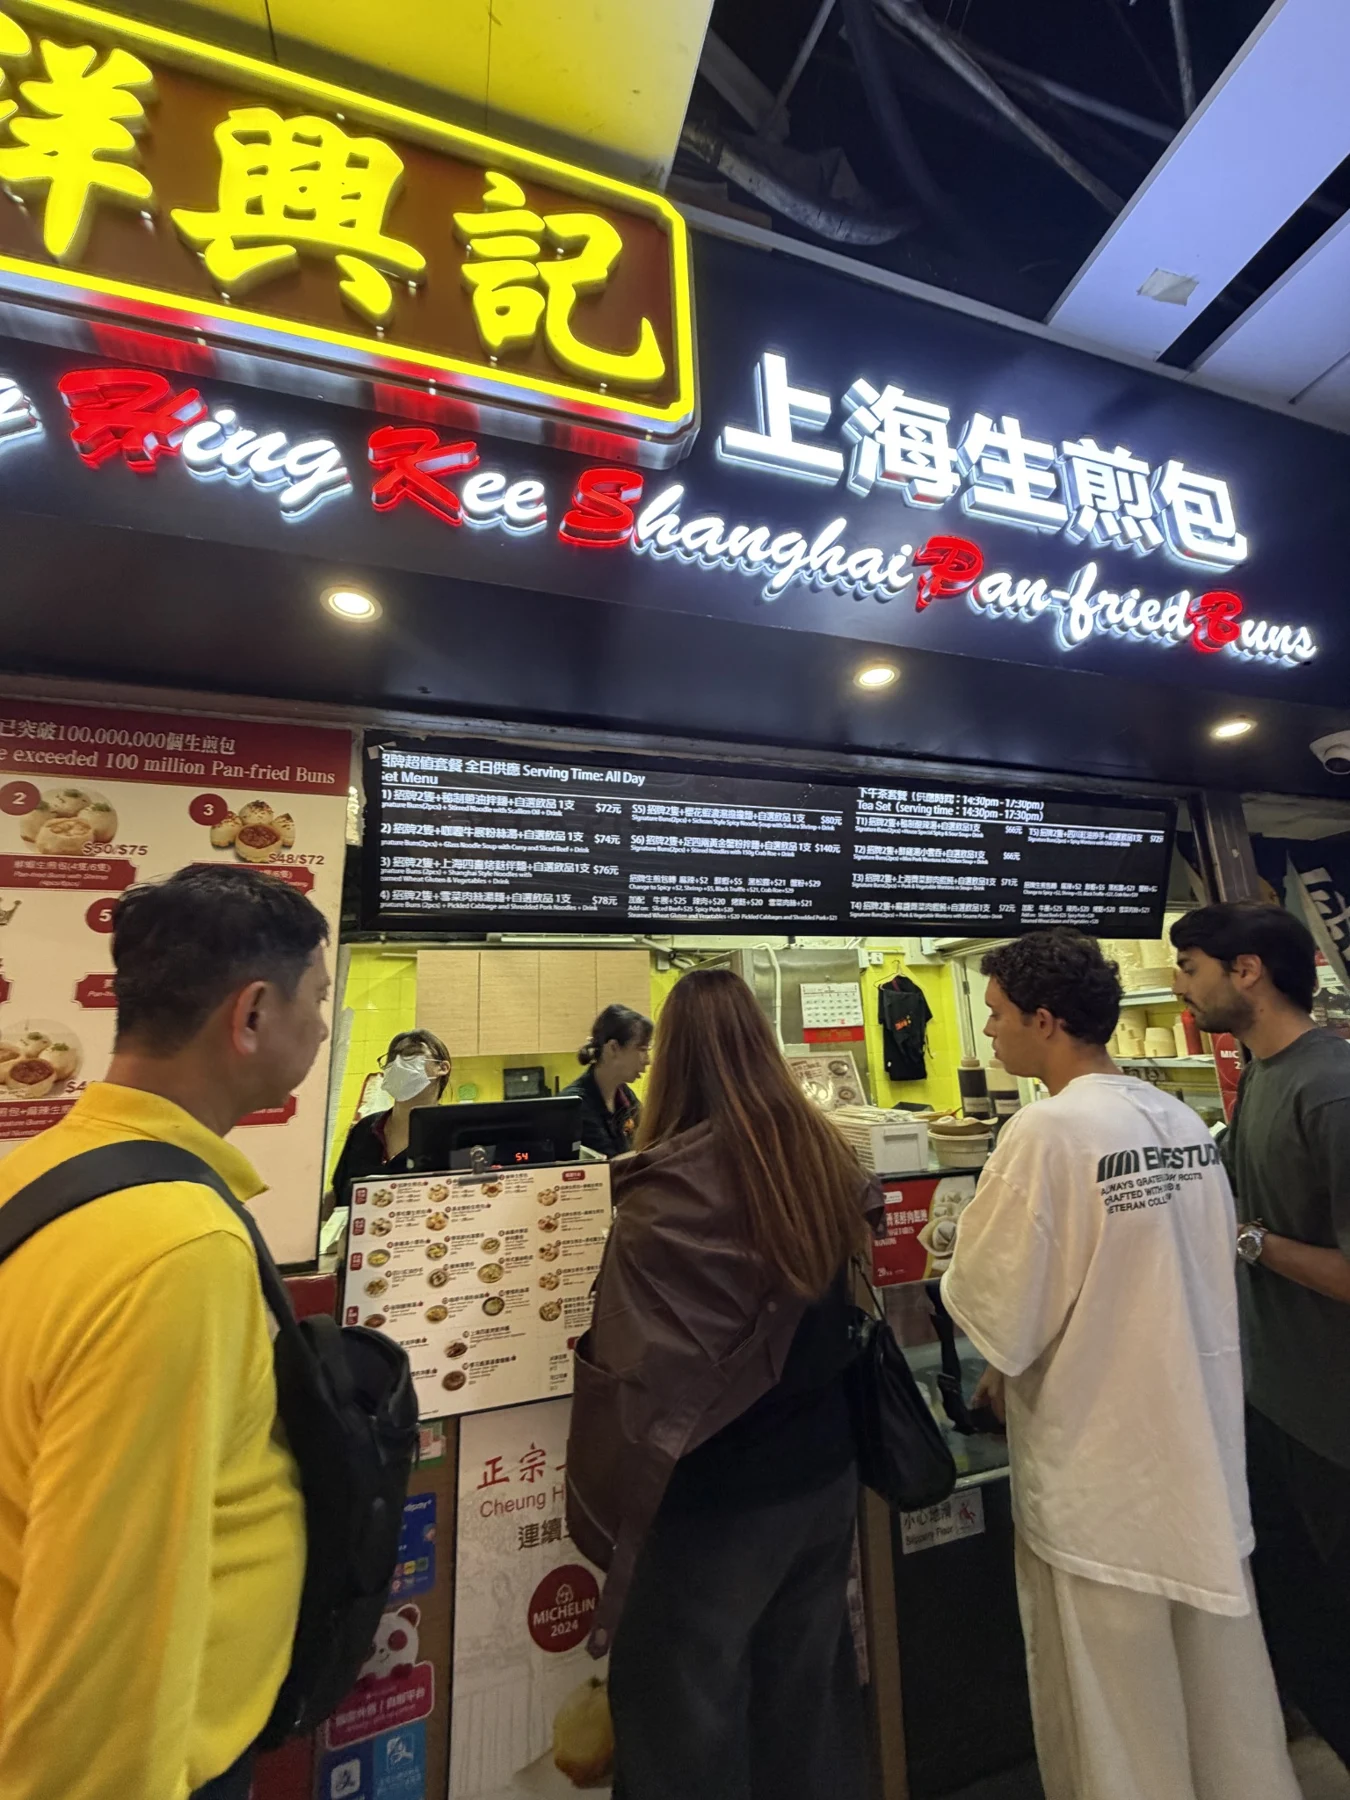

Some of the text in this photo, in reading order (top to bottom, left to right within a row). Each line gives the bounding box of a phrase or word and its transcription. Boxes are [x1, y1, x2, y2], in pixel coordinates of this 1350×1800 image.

[718, 352, 1247, 572] 上海生煎包
[367, 425, 547, 531] Kee
[559, 467, 914, 600] Shanghai
[913, 535, 1196, 650] Pan-fried
[1187, 591, 1318, 665] Buns
[13, 749, 98, 767] exceeded
[105, 753, 139, 769] 100
[143, 757, 205, 775] million
[212, 760, 290, 781] Pan-fried
[296, 767, 335, 784] Buns
[401, 771, 438, 784] Menu
[465, 760, 520, 776] 全日供應
[522, 764, 569, 782] Serving
[570, 768, 604, 781] Time:
[605, 771, 621, 783] All
[623, 772, 645, 787] Day
[12, 793, 27, 805] 2
[203, 804, 214, 816] 3
[595, 803, 622, 814] $72元
[856, 800, 874, 811] Tea
[875, 801, 891, 812] Set
[594, 834, 621, 845] $74元
[83, 842, 148, 855] $50/$75
[269, 853, 325, 865] $48/$72
[593, 865, 619, 876] $76元
[592, 895, 618, 906] $78元
[99, 909, 112, 922] 5
[1104, 1190, 1143, 1206] CRAFTED
[476, 1441, 567, 1489] 正宗
[480, 1492, 546, 1518] Cheung
[517, 1517, 569, 1550] 連續
[532, 1597, 595, 1627] MICHELIN
[550, 1619, 578, 1637] 2024
